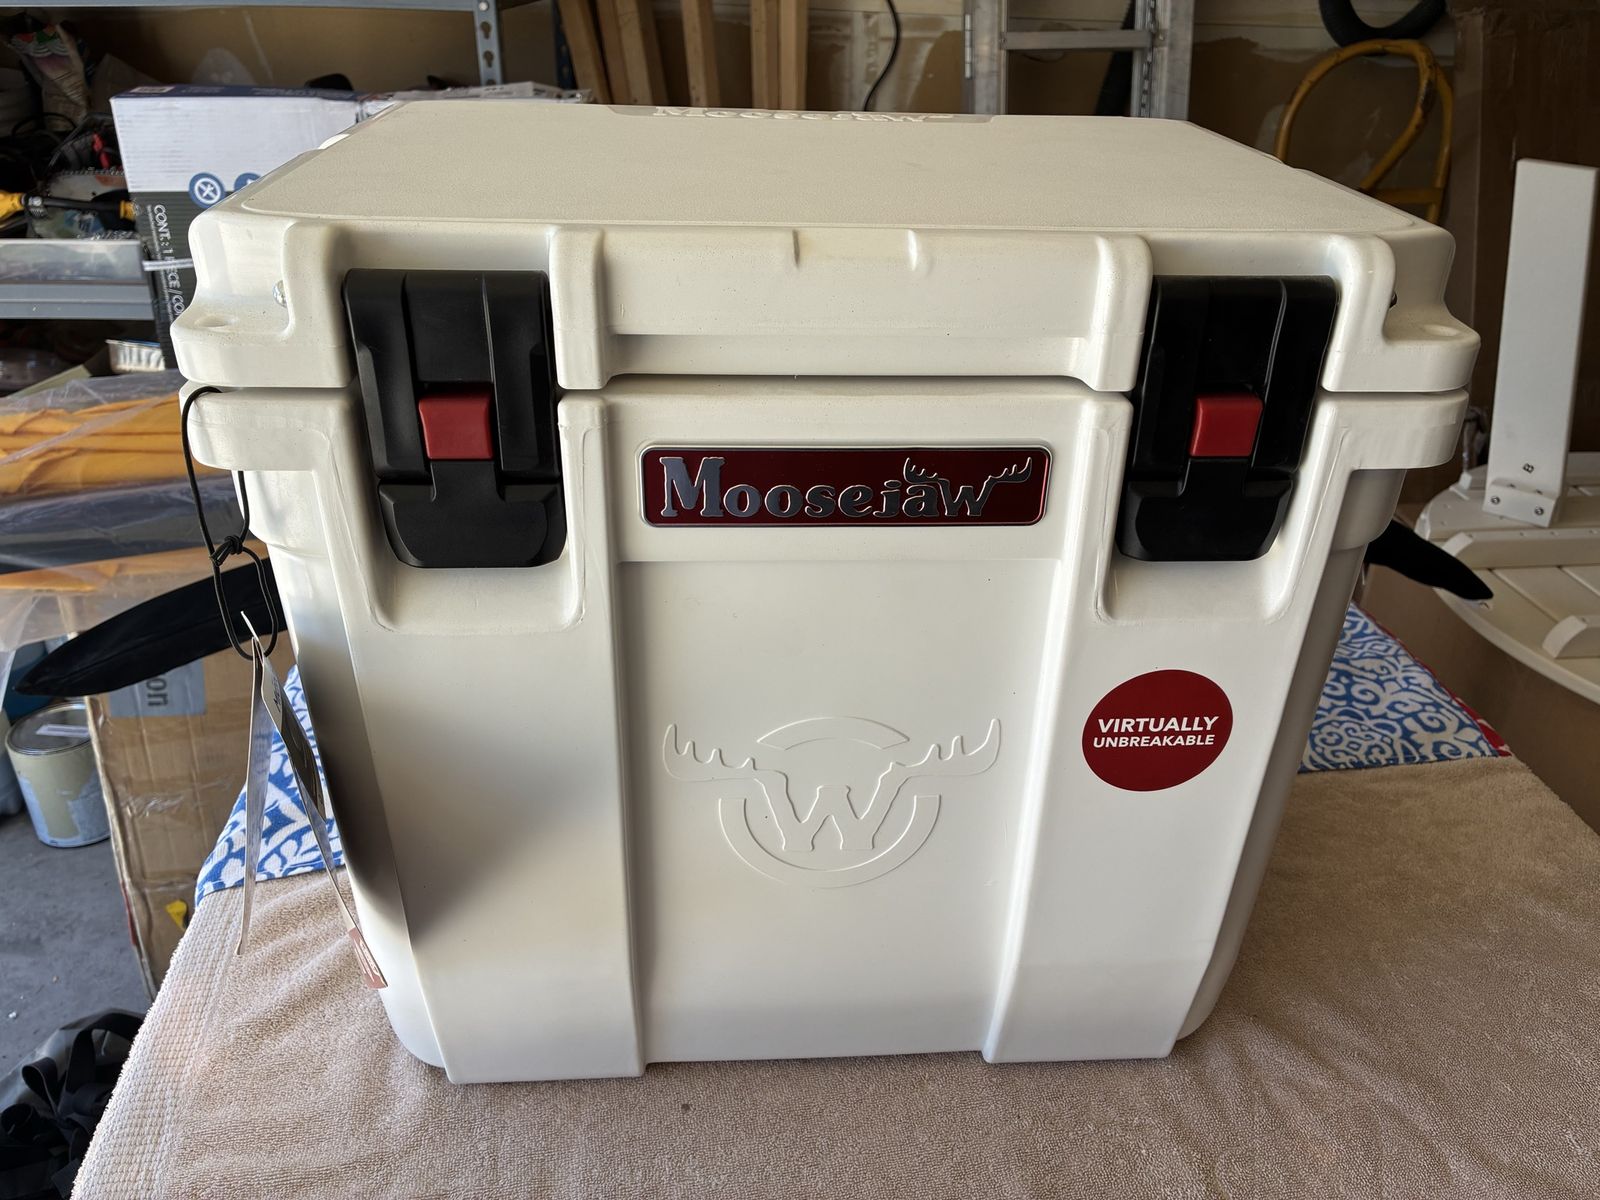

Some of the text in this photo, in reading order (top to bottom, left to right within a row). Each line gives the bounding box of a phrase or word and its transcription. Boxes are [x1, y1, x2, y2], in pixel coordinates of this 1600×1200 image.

[658, 456, 1033, 517] Moosejaw
[1098, 716, 1219, 733] VIRTUALLY
[1093, 734, 1215, 748] UNBREAKABLE
